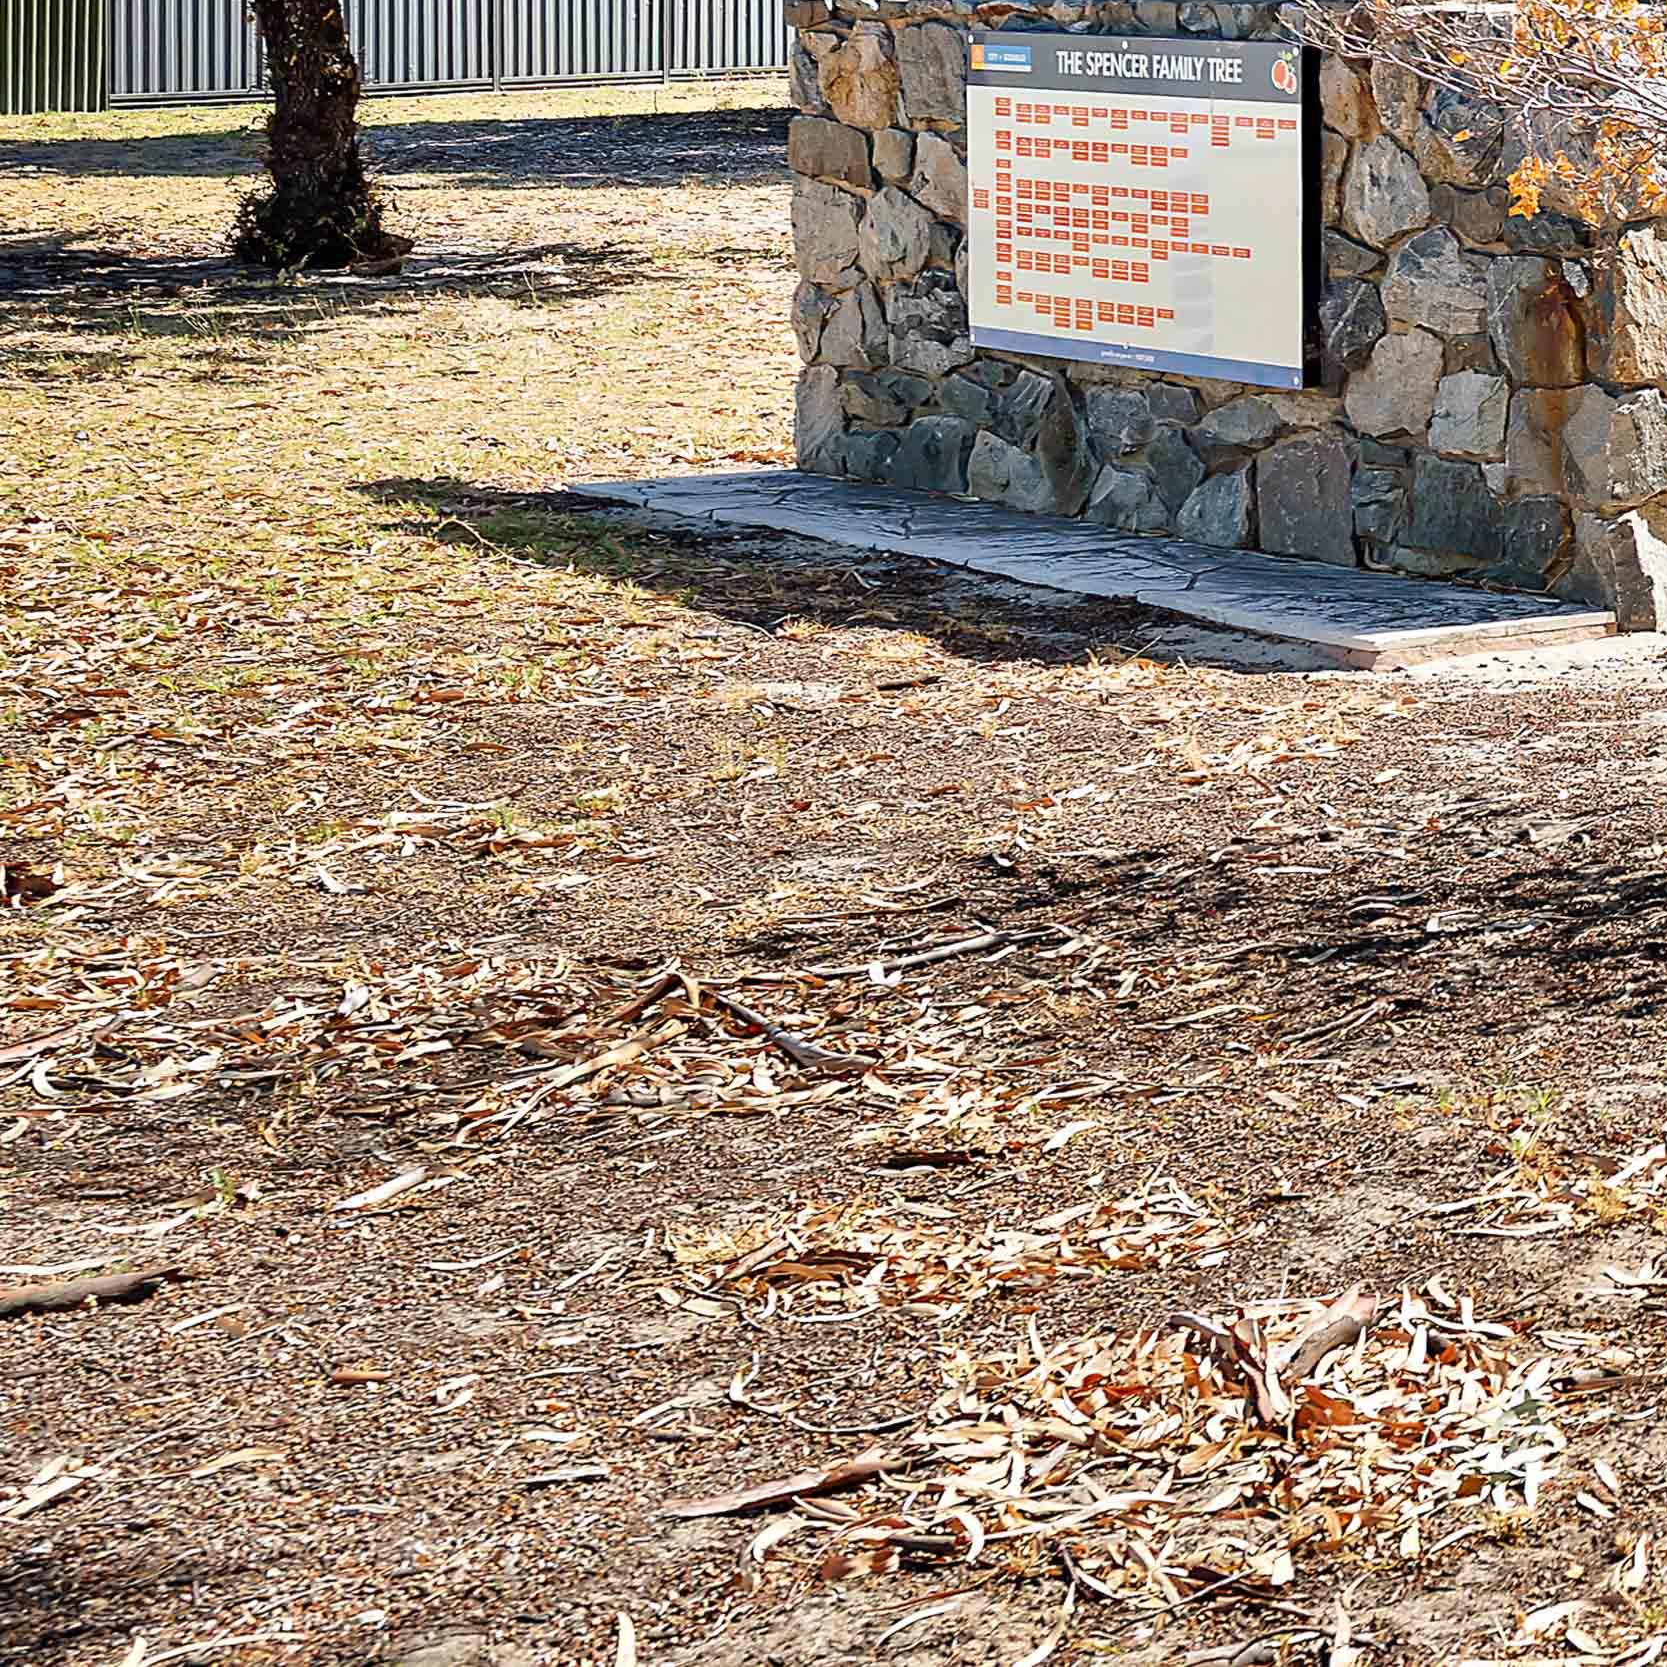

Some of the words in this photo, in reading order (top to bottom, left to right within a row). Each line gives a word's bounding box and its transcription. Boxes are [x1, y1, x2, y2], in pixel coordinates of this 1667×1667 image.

[1056, 50, 1083, 75] THE
[1086, 51, 1149, 79] SPENCER
[1152, 54, 1205, 81] FAMILY
[1207, 57, 1243, 83] TREE
